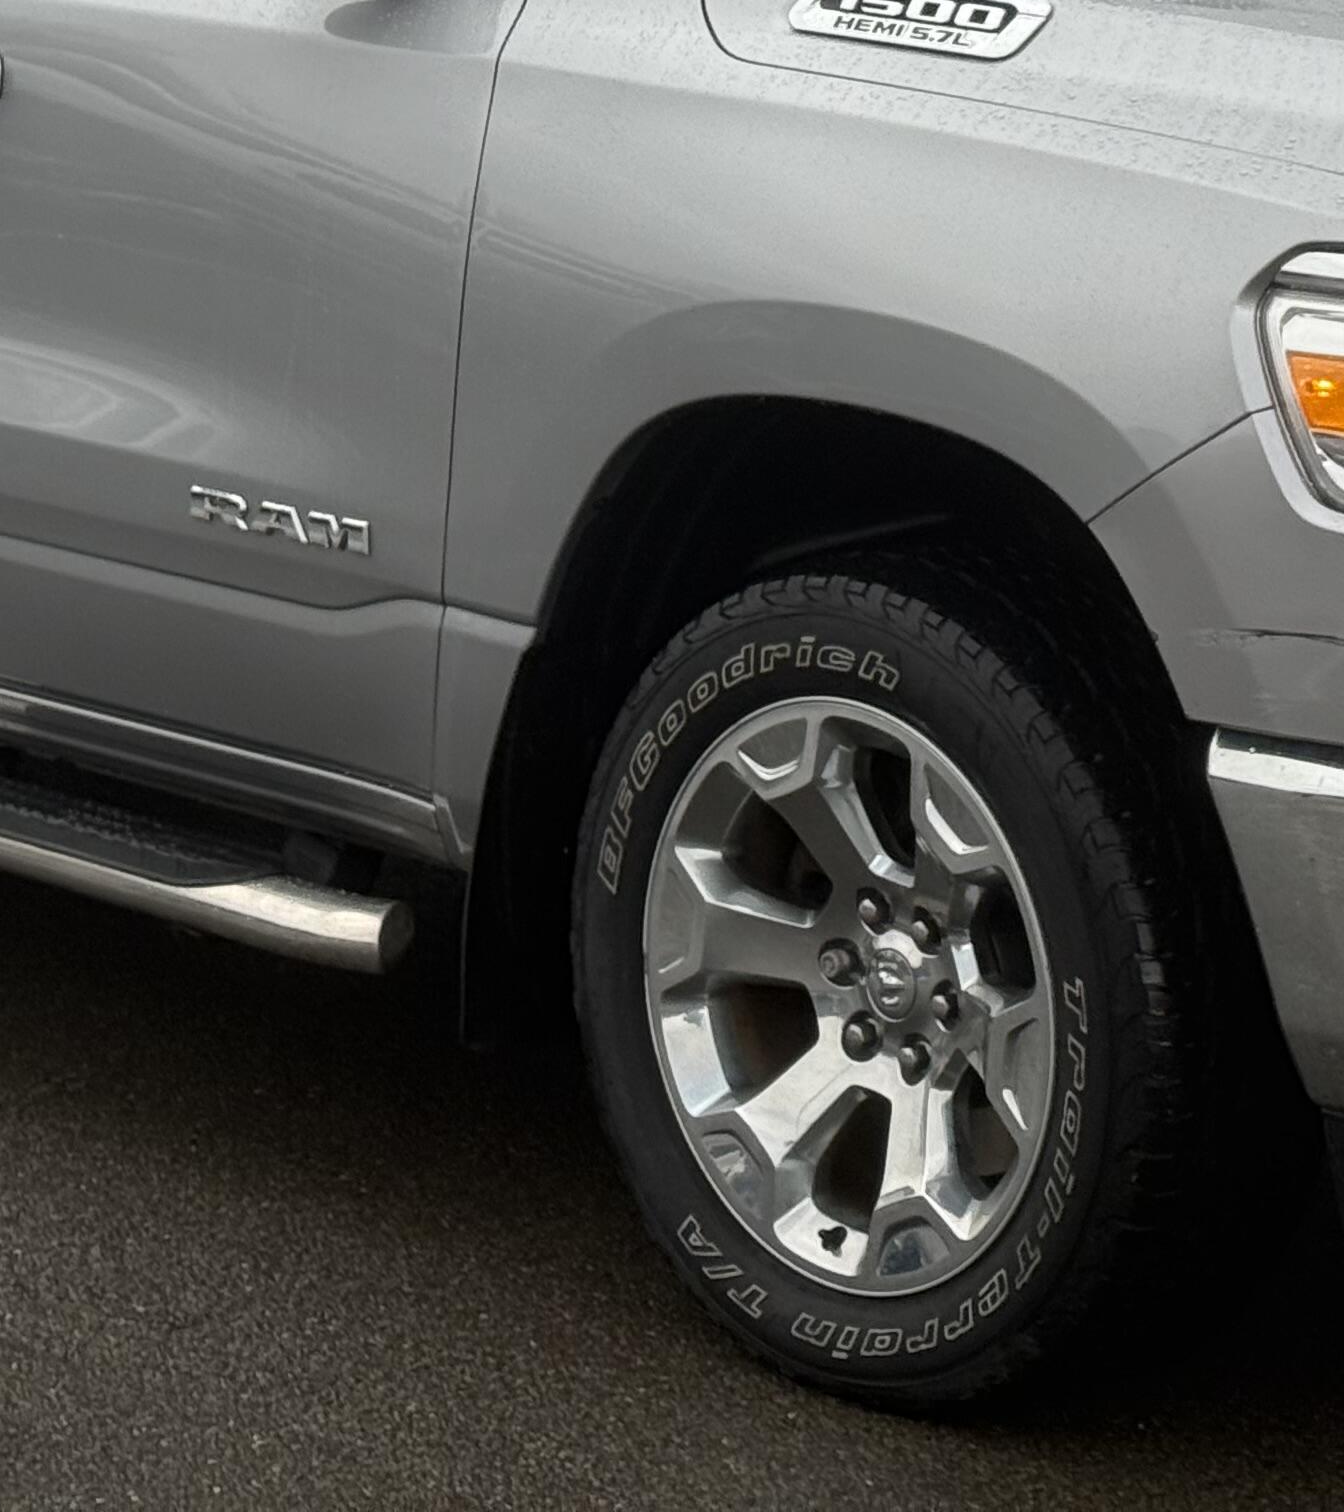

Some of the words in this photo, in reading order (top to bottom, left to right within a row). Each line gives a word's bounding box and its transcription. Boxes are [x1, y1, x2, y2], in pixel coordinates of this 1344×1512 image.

[833, 15, 906, 37] HEMI
[909, 25, 972, 48] 5.7L
[190, 484, 371, 555] RAM
[596, 635, 900, 896] BFGoodrich
[676, 1214, 768, 1319] T/A
